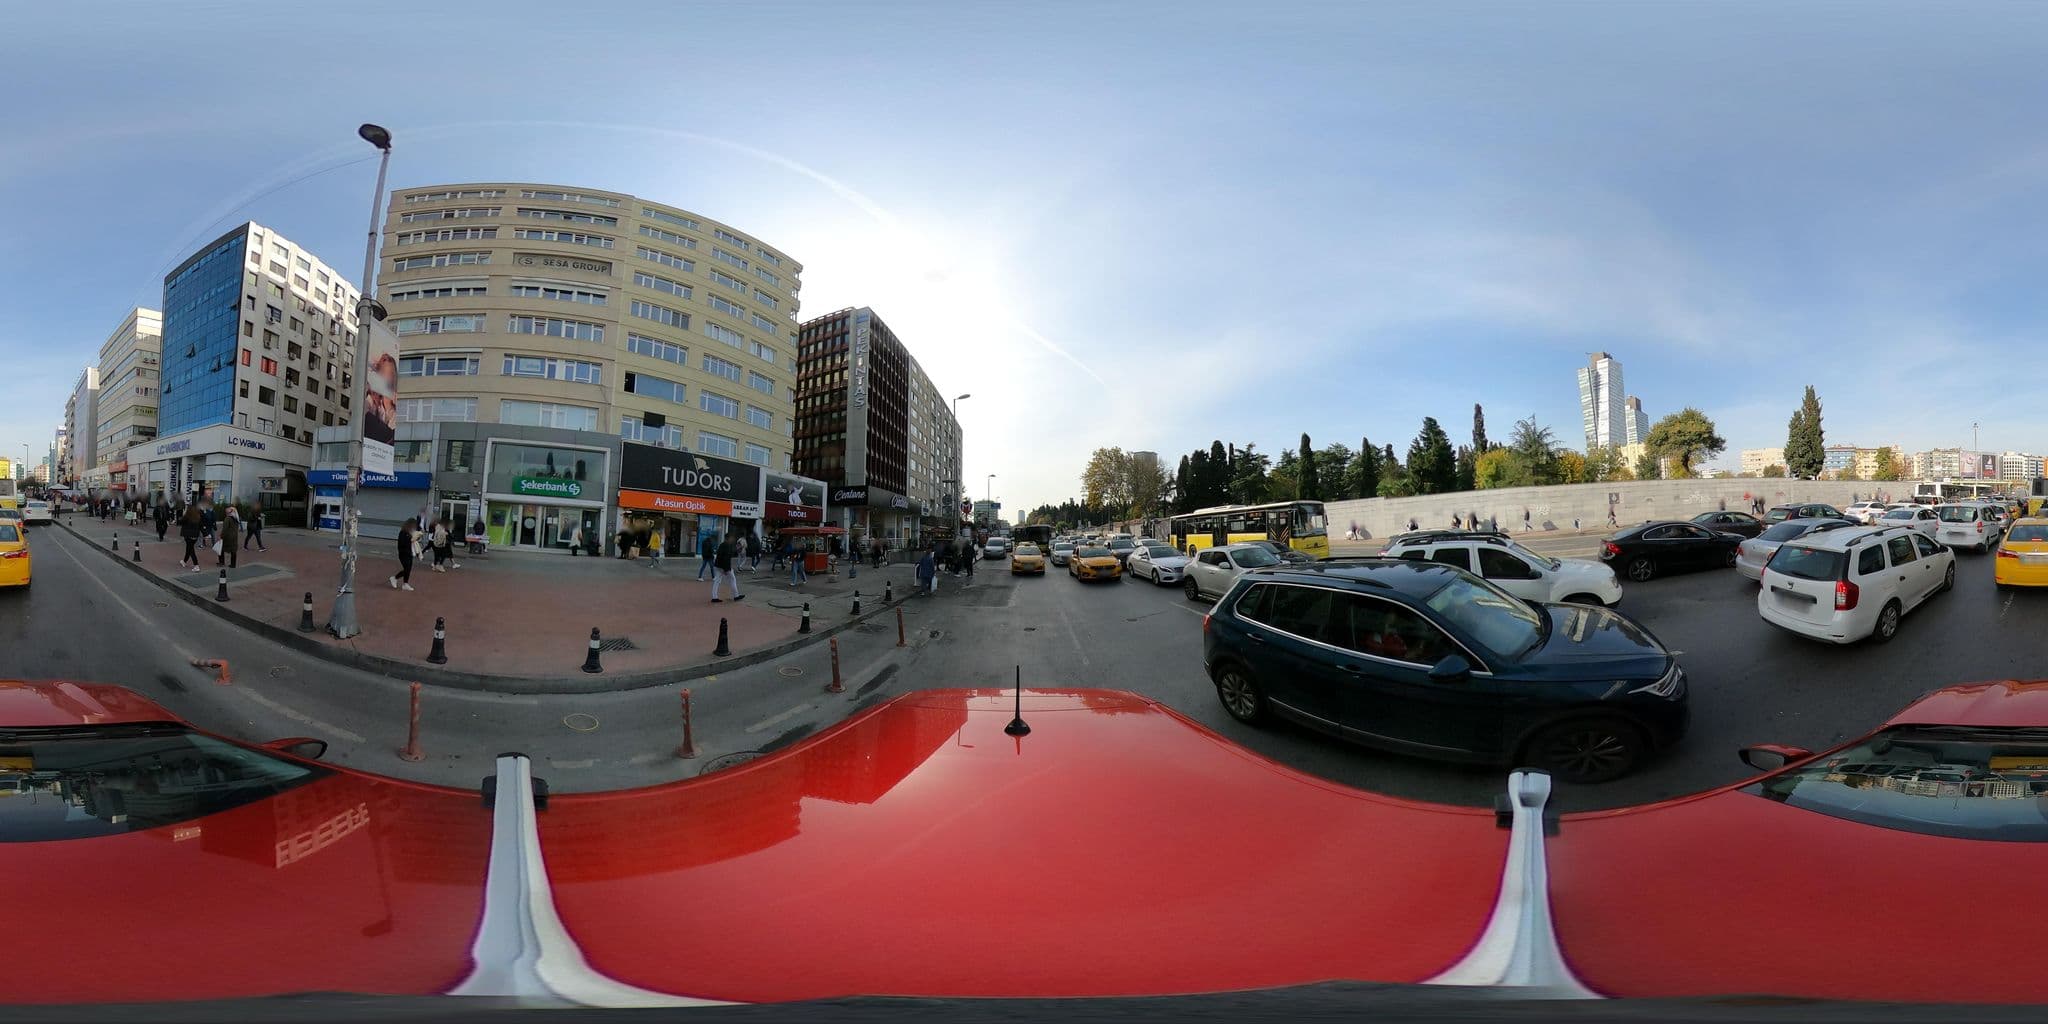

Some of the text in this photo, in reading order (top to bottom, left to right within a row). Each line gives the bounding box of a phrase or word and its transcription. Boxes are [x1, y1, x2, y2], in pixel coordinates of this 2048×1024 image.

[543, 258, 608, 273] SESA GROUP
[228, 436, 239, 445] LC
[520, 479, 568, 492] Şekerbank
[661, 466, 732, 492] TUDORS
[654, 497, 706, 511] Atasun Optik
